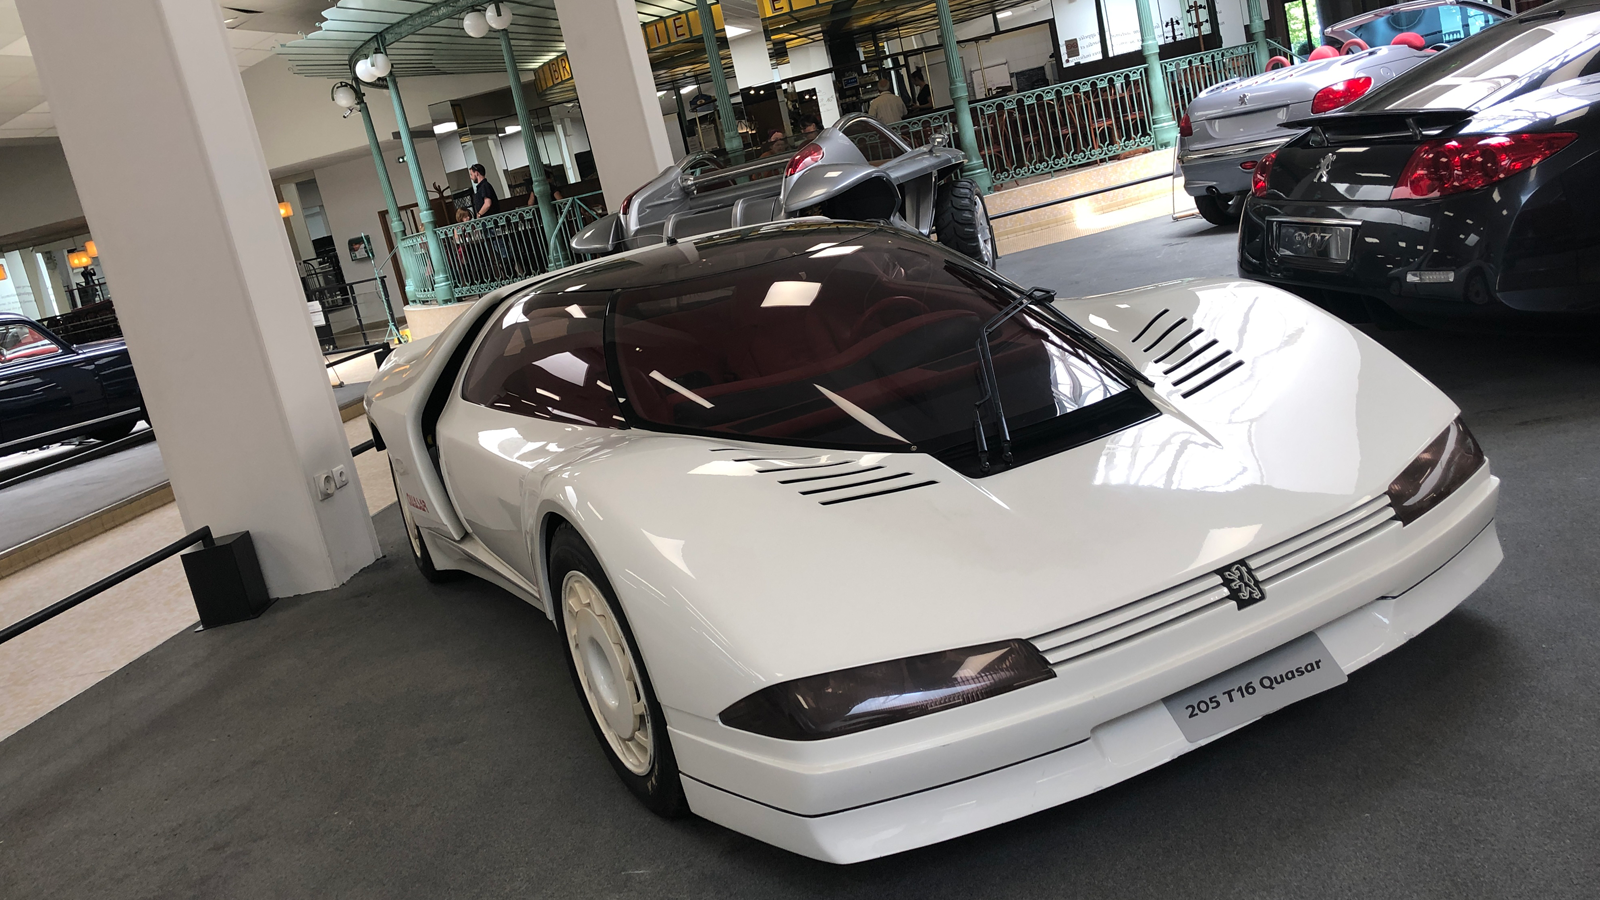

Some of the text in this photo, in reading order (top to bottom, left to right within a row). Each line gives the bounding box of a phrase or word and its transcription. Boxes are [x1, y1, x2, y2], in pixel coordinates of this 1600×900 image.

[1294, 231, 1332, 249] 907
[1185, 659, 1322, 719] 205 T16 Quasar
